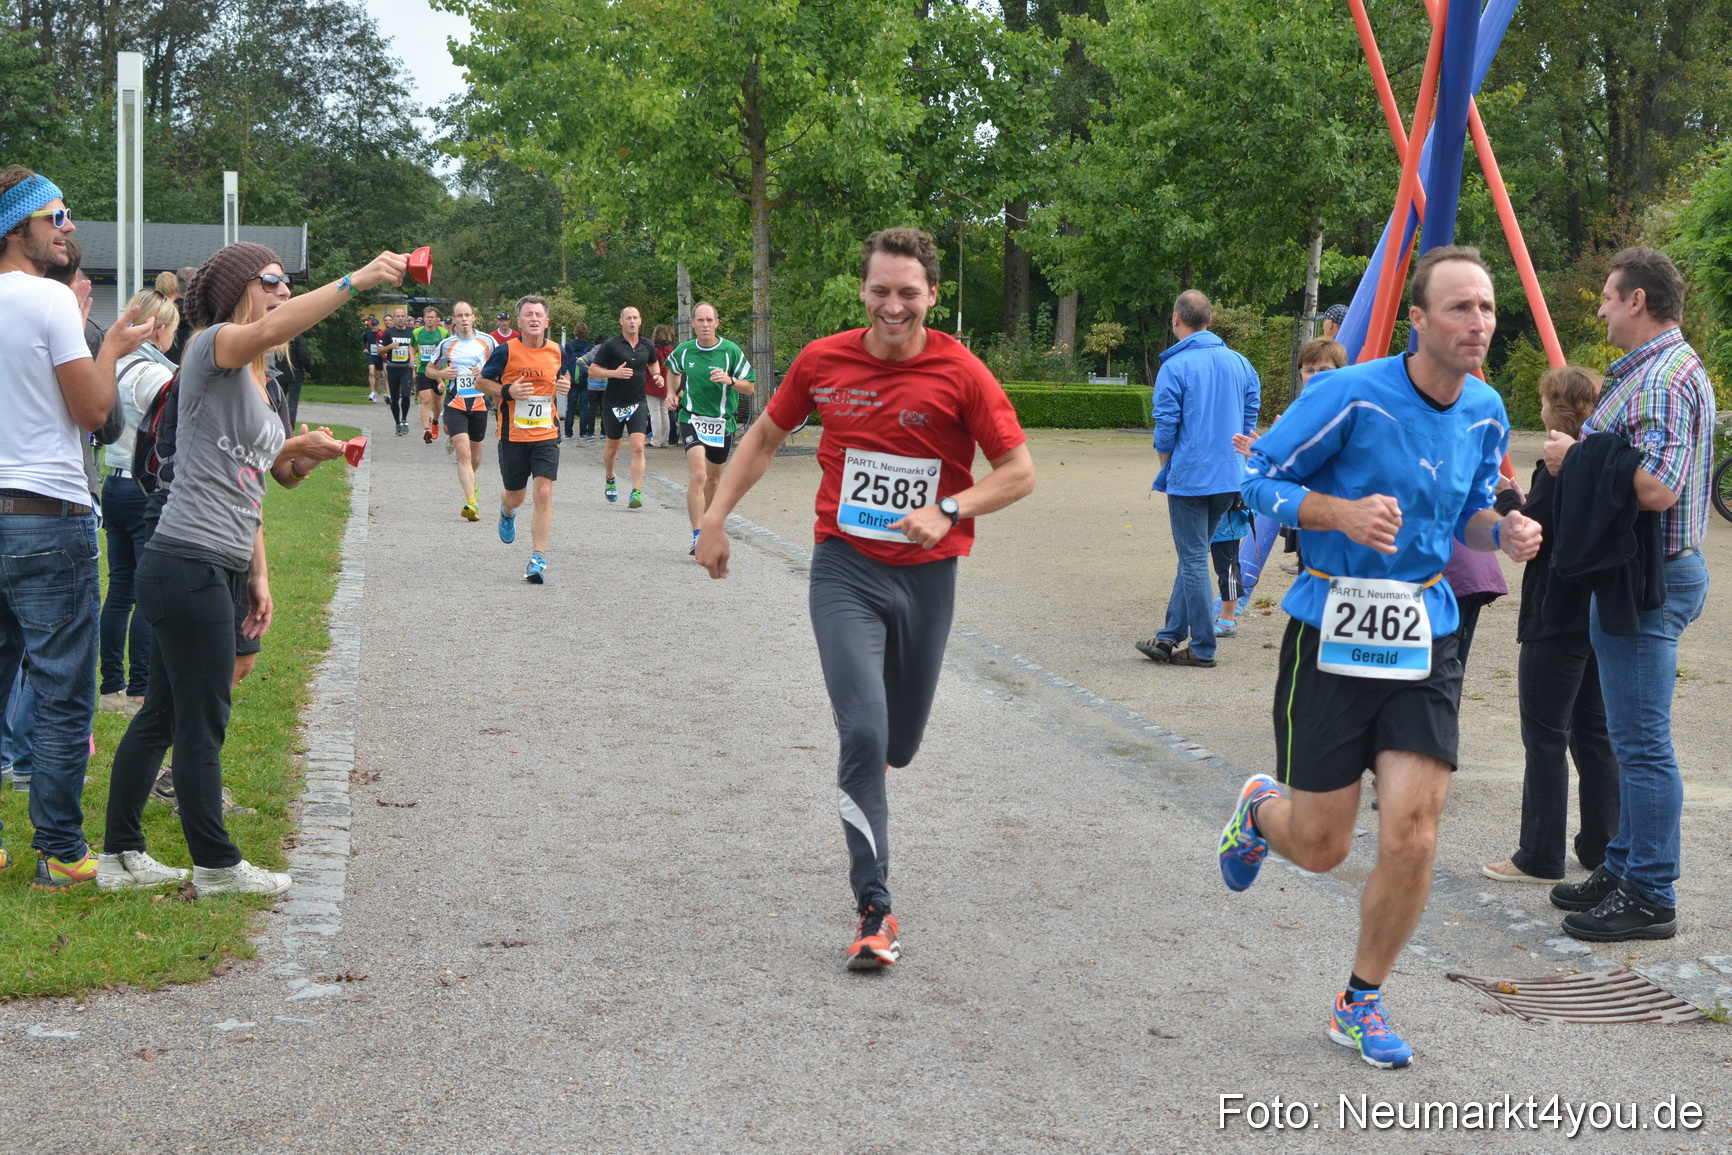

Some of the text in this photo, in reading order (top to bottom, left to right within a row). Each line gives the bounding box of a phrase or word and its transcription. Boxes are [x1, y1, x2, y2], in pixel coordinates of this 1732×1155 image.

[528, 404, 542, 417] 70
[252, 420, 285, 454] NO
[694, 422, 722, 435] 2392
[847, 456, 924, 475] PARTL Neumarkt
[851, 471, 928, 509] 2583
[1331, 586, 1411, 601] PARTL Neumarkt
[1333, 602, 1421, 642] 2462
[1351, 648, 1398, 665] Gerald
